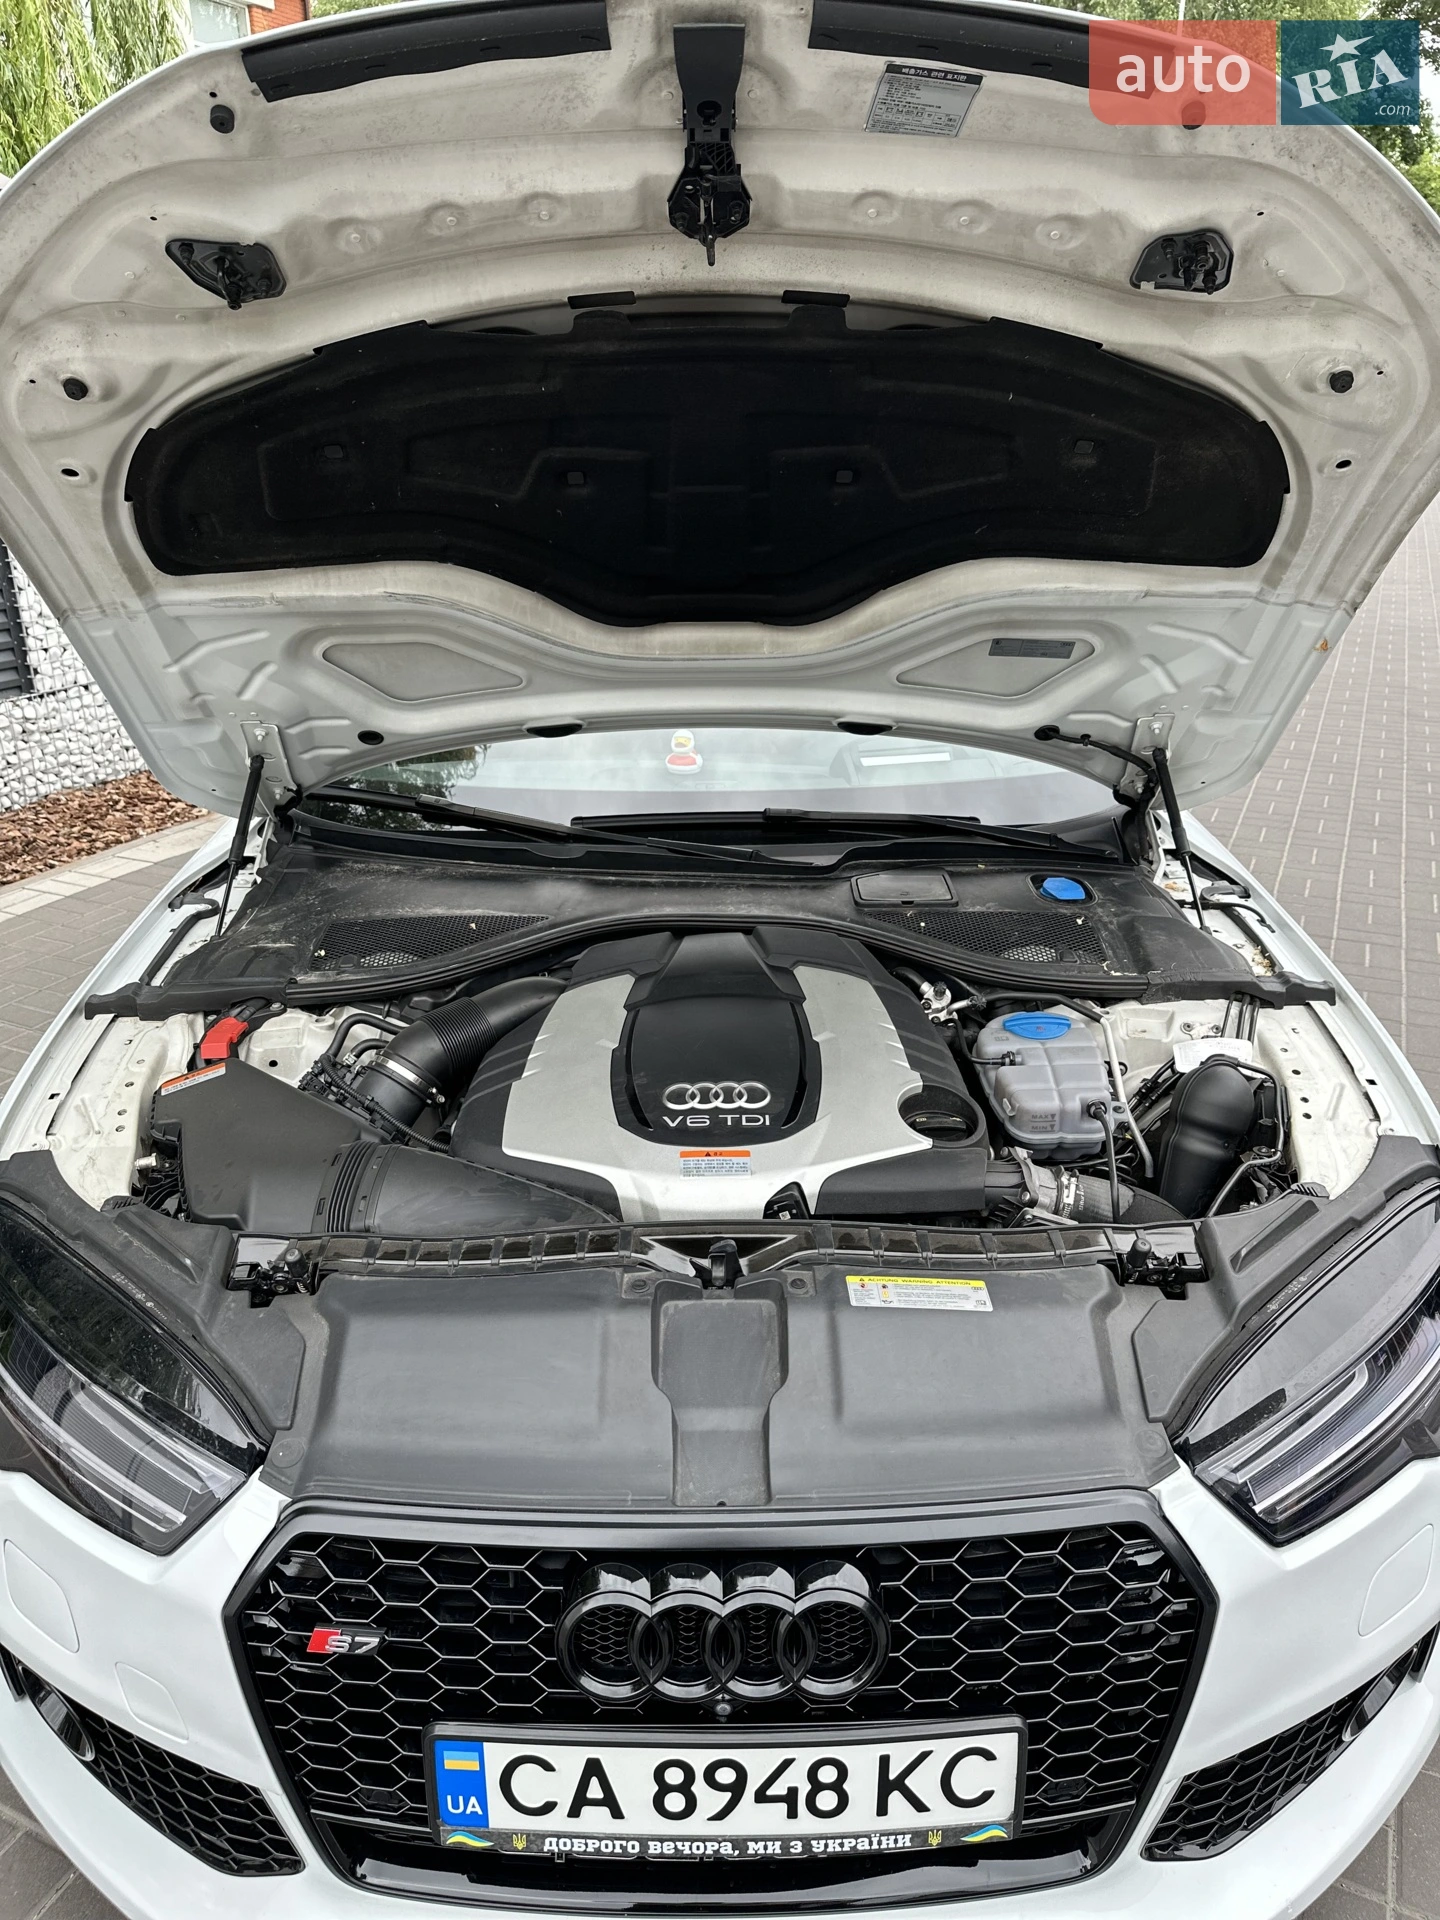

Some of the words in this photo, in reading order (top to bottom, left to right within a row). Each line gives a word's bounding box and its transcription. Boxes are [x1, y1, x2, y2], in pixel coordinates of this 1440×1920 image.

[662, 1114, 710, 1127] V6
[718, 1114, 770, 1126] TDI
[326, 1636, 380, 1653] S7
[651, 1756, 851, 1822] 8948
[446, 1794, 484, 1816] UA
